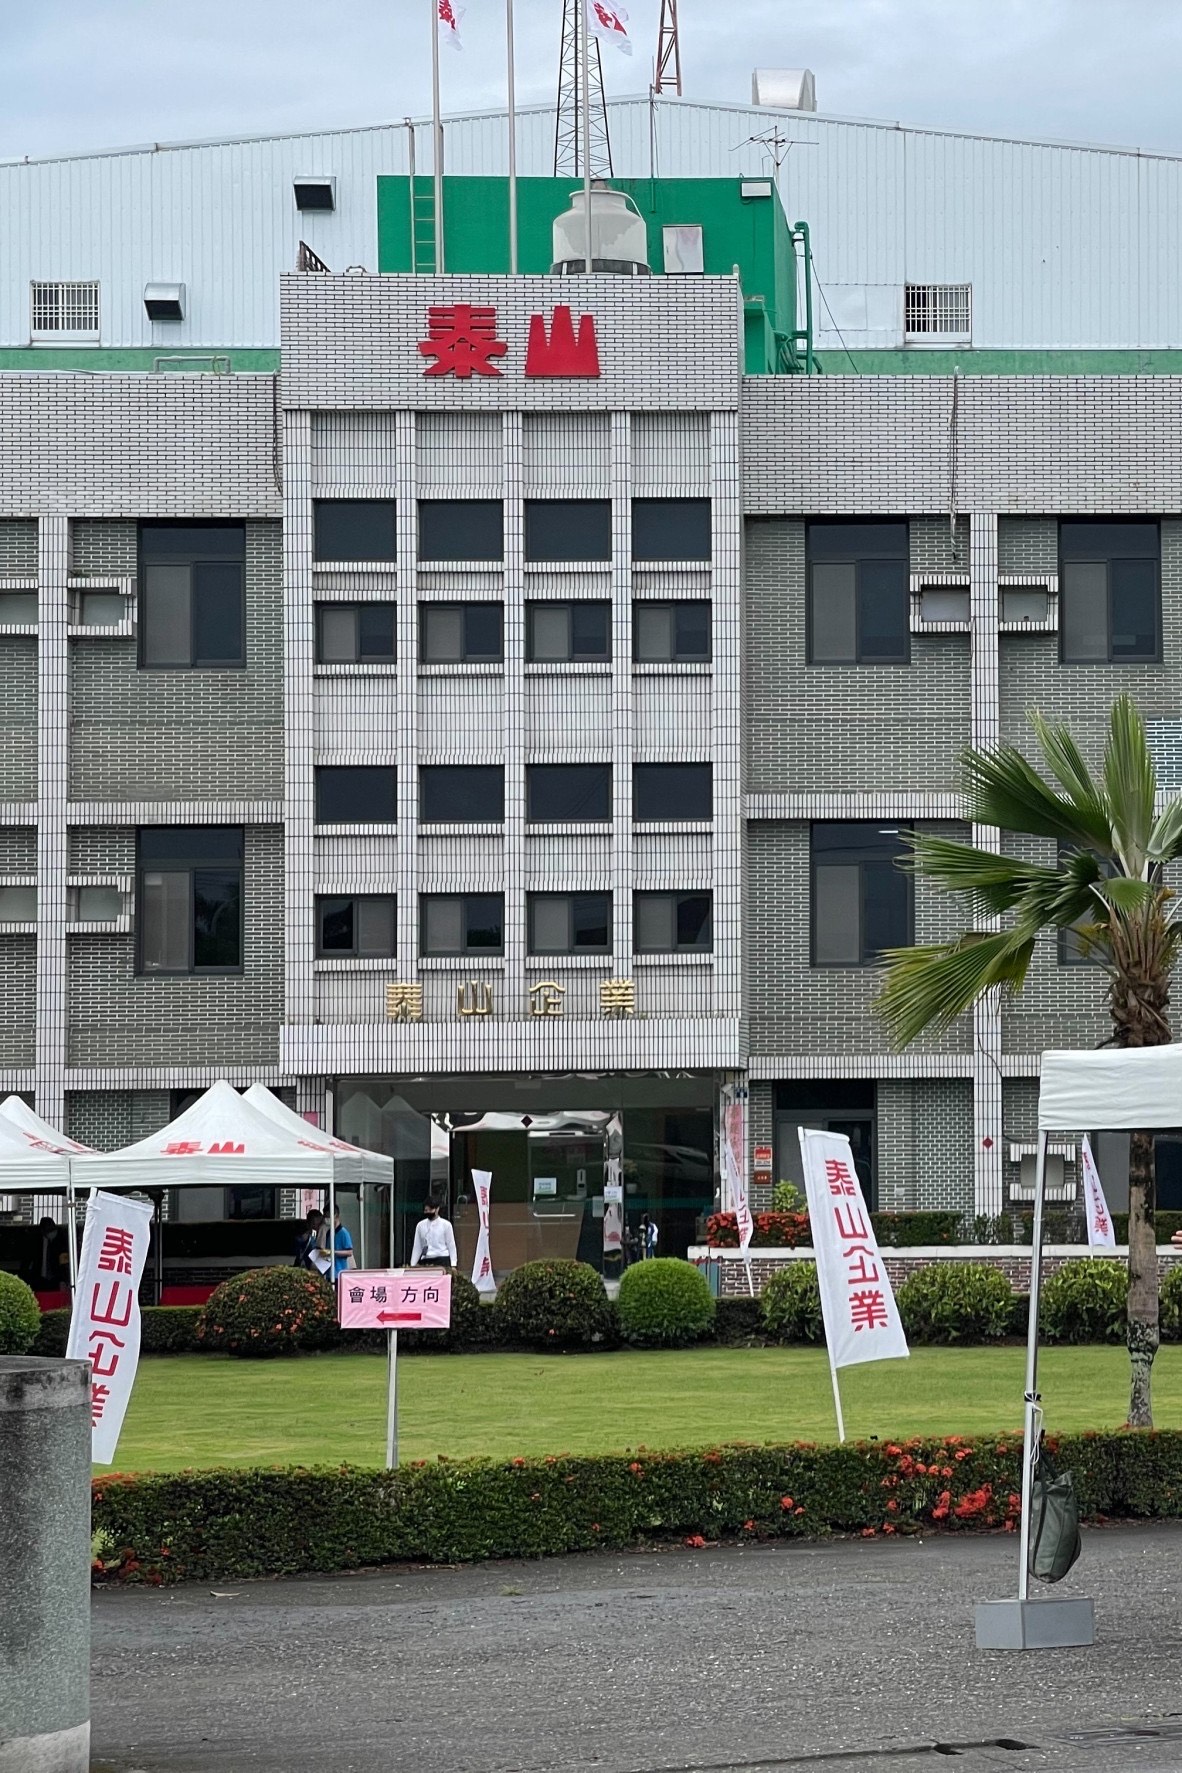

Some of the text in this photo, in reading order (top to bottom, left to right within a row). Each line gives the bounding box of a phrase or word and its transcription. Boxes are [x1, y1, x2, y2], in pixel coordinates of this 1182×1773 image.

[417, 303, 601, 379] 泰山
[386, 979, 636, 1019] 泰山企業
[160, 1140, 246, 1155] 泰山
[825, 1158, 888, 1332] 泰山企業
[348, 1286, 439, 1303] 會場 方向
